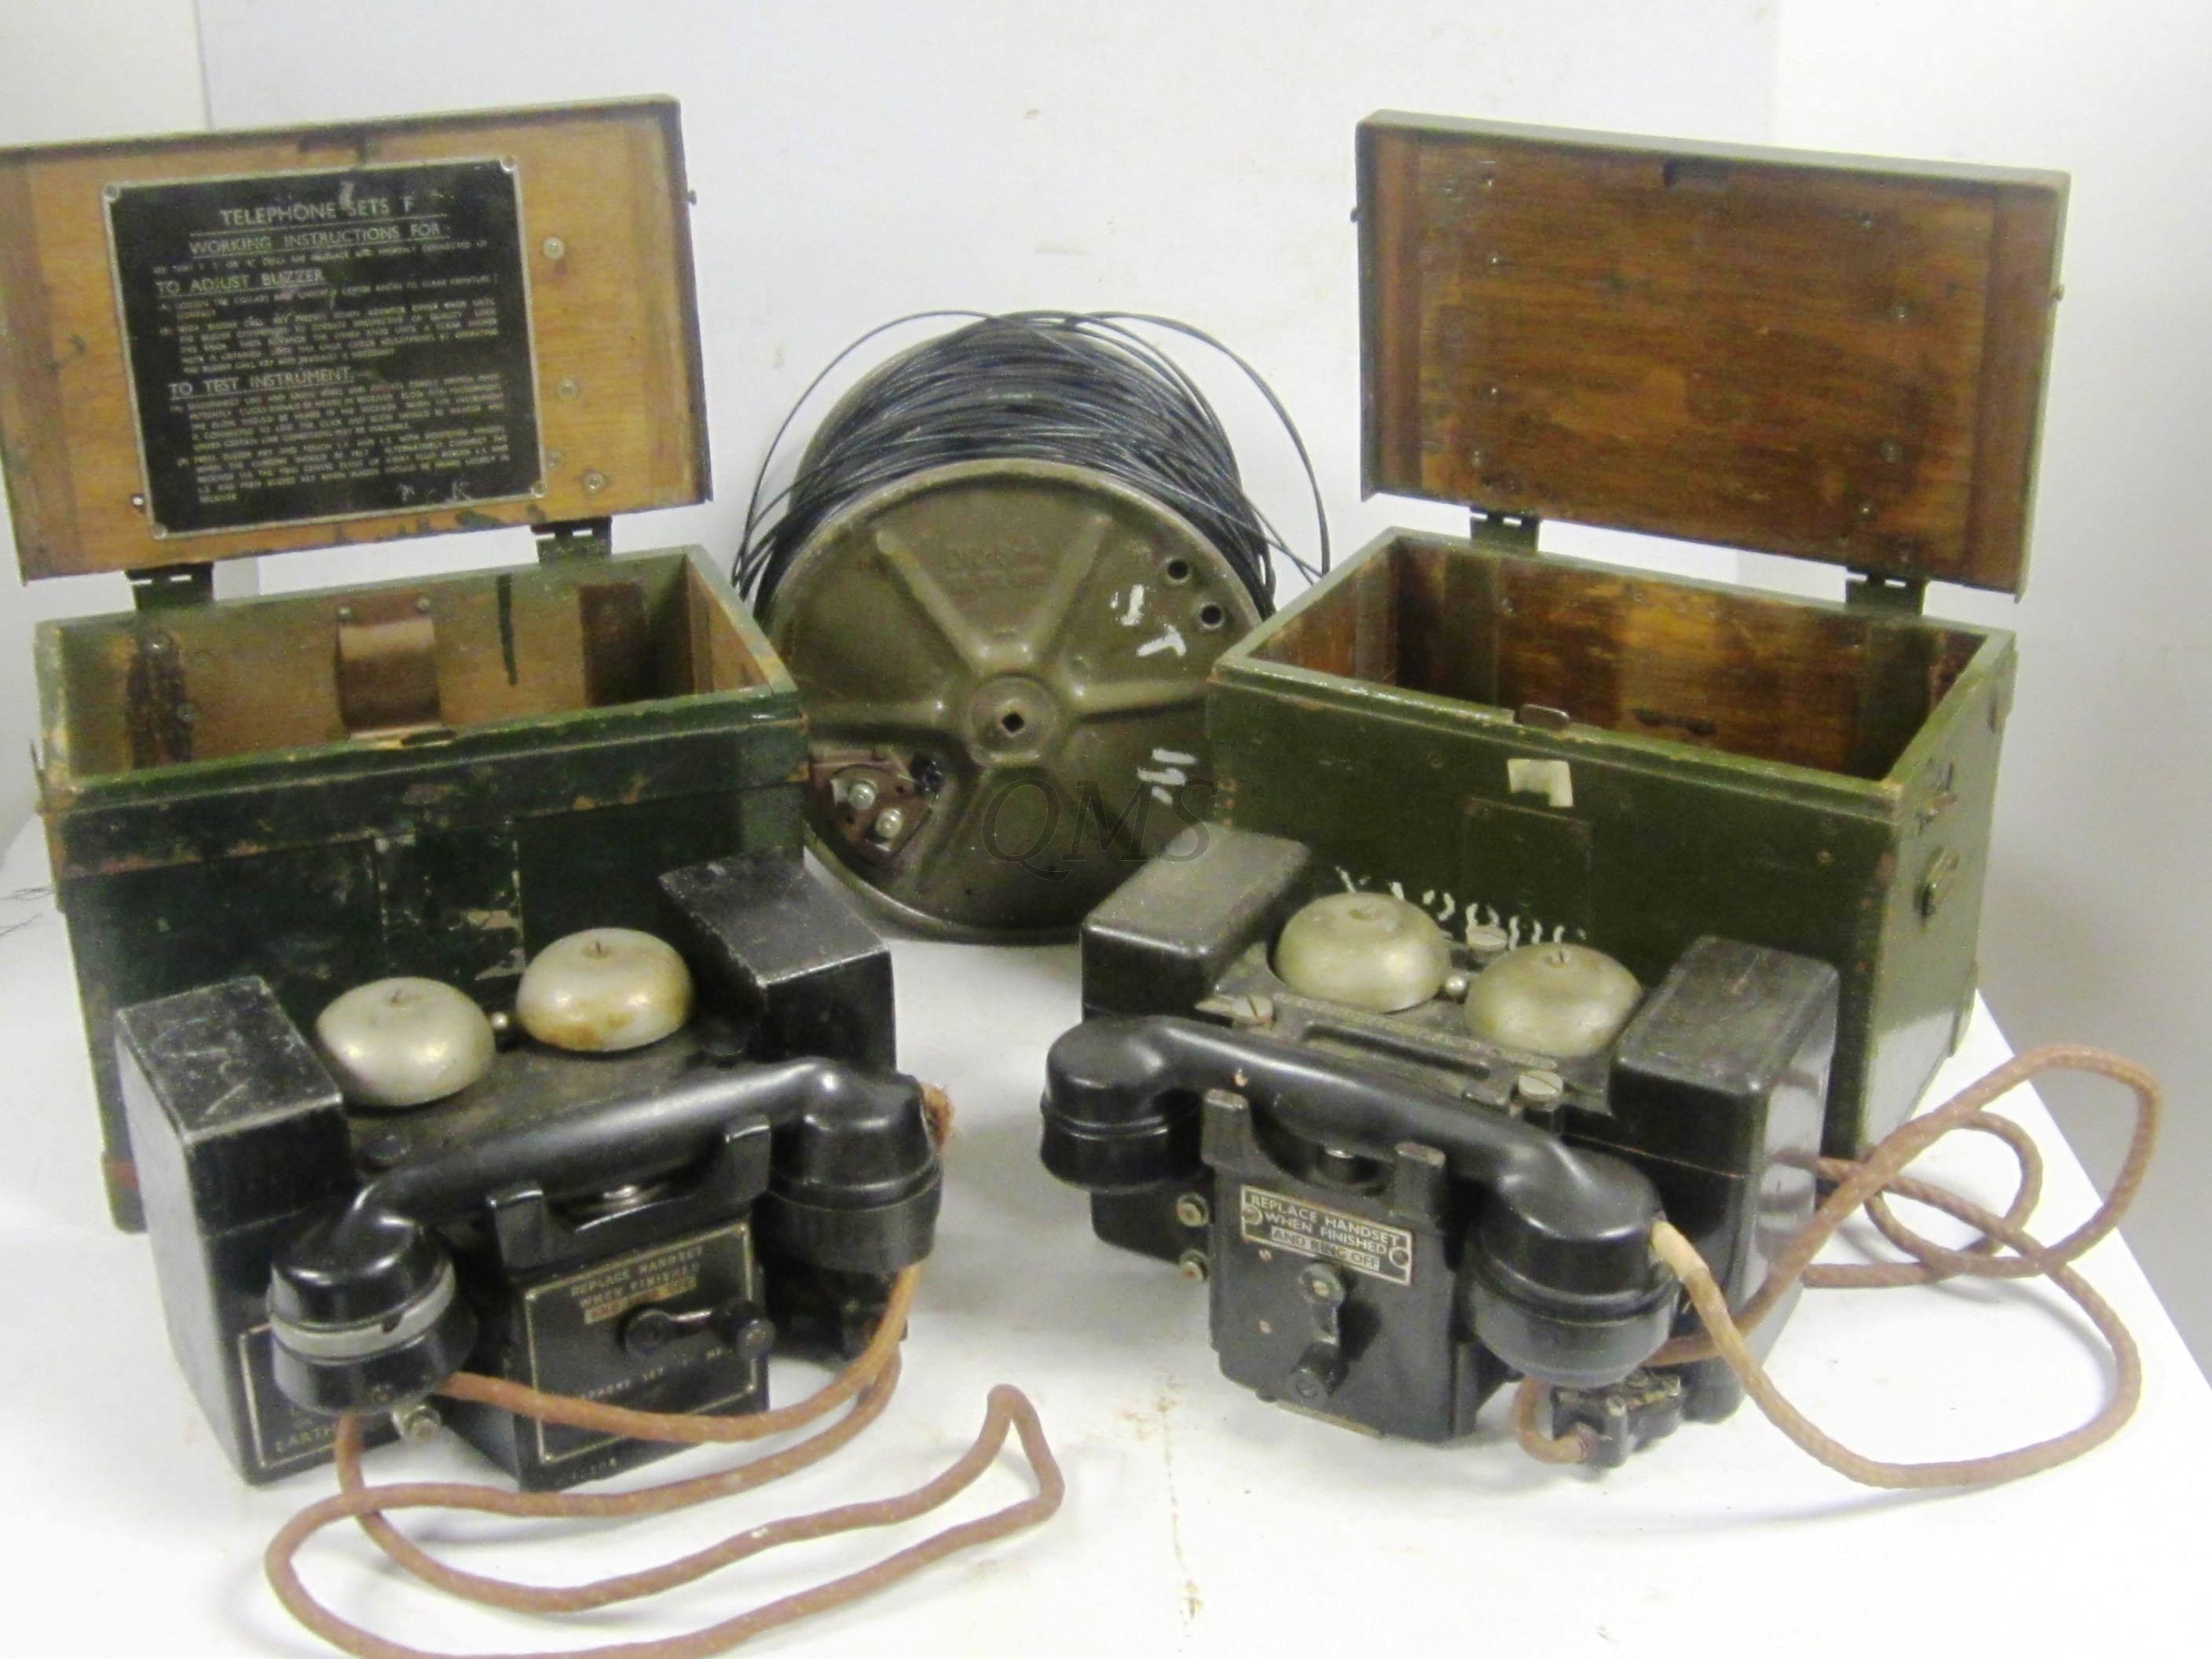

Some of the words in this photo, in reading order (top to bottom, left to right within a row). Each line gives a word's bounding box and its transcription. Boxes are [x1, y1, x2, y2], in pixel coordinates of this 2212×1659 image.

[219, 200, 337, 227] TELEPHONE
[348, 196, 390, 218] SETS
[401, 194, 416, 212] F
[189, 235, 272, 255] WORKING
[283, 225, 400, 247] INSTRUCTIONS
[155, 280, 181, 296] TO
[188, 273, 250, 293] ADJUST
[260, 267, 324, 286] BUZZER
[167, 380, 193, 397] TO
[203, 376, 240, 394] TEST
[1251, 1194, 1317, 1223] REPLACE
[1324, 1215, 1399, 1247] HANDSET
[1265, 1210, 1312, 1233] WHEN
[1320, 1226, 1386, 1255] FINISHED
[1273, 1227, 1306, 1247] AND
[1350, 1251, 1379, 1269] OFF
